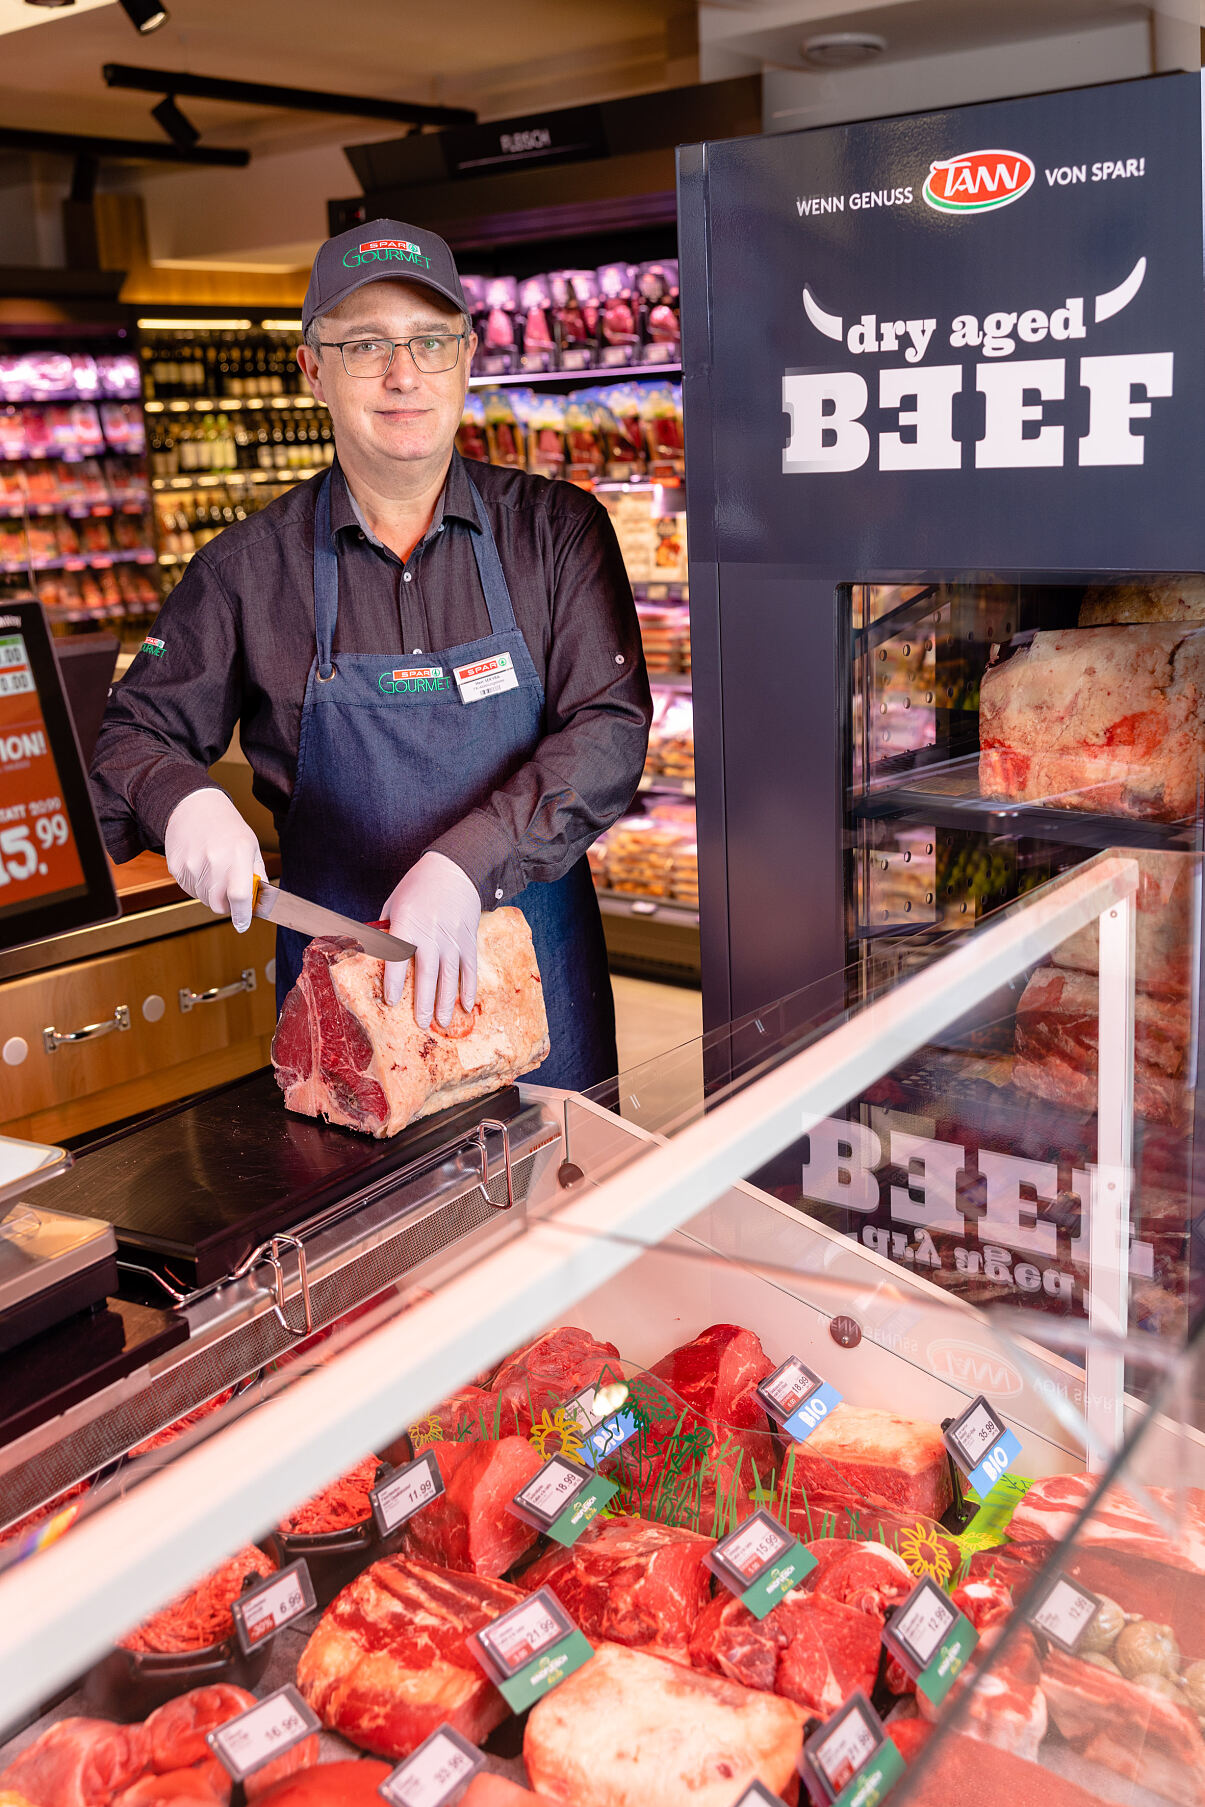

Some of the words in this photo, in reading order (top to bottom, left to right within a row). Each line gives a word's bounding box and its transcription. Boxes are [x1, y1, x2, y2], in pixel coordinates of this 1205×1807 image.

[934, 160, 1021, 198] TANN
[1045, 164, 1087, 187] VON
[1091, 157, 1146, 182] SPAR!
[796, 195, 844, 217] WENN
[849, 187, 914, 212] GENUSS
[369, 241, 406, 249] SPAR
[342, 248, 432, 269] GOURMET
[846, 314, 937, 364] dry
[949, 297, 1087, 358] aged
[401, 670, 430, 678] SPAR
[467, 662, 497, 676] SPAR
[378, 672, 452, 694] GOURMET
[792, 1376, 809, 1393] 18.99
[797, 1398, 828, 1429] BIO
[978, 1420, 995, 1442] 35.99
[981, 1446, 1009, 1482] BIO
[408, 1479, 432, 1503] 11.99
[555, 1473, 577, 1494] 18.99
[756, 1534, 778, 1555] 15.99
[279, 1592, 302, 1614] 6.99
[928, 1605, 947, 1632] 12.99
[526, 1618, 555, 1644] 21.99
